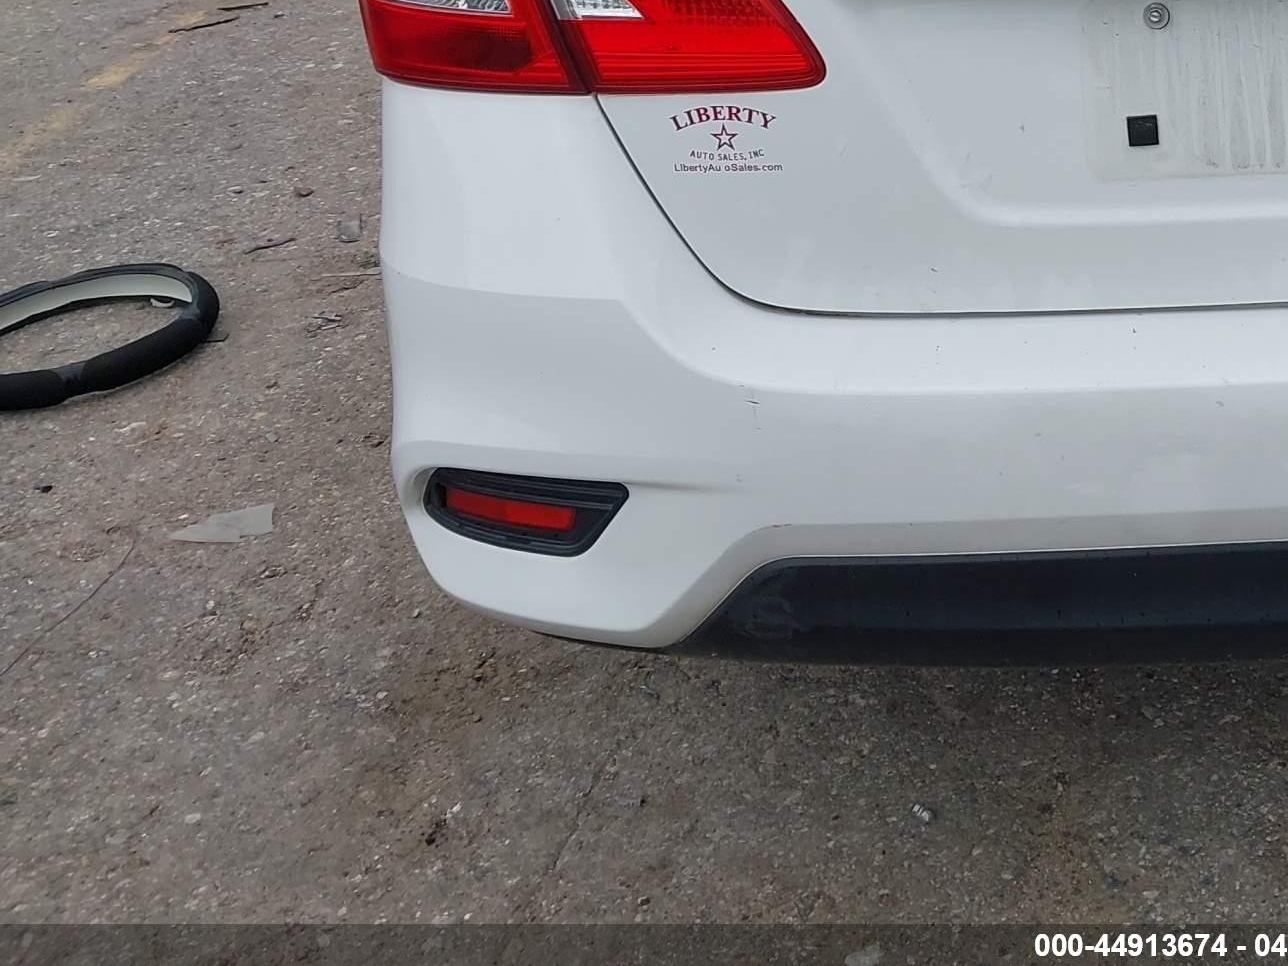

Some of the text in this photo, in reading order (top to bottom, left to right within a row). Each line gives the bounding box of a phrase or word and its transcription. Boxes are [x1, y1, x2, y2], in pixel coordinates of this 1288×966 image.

[669, 105, 777, 131] LIBERTY
[689, 150, 714, 161] AUTO
[749, 148, 765, 160] INC
